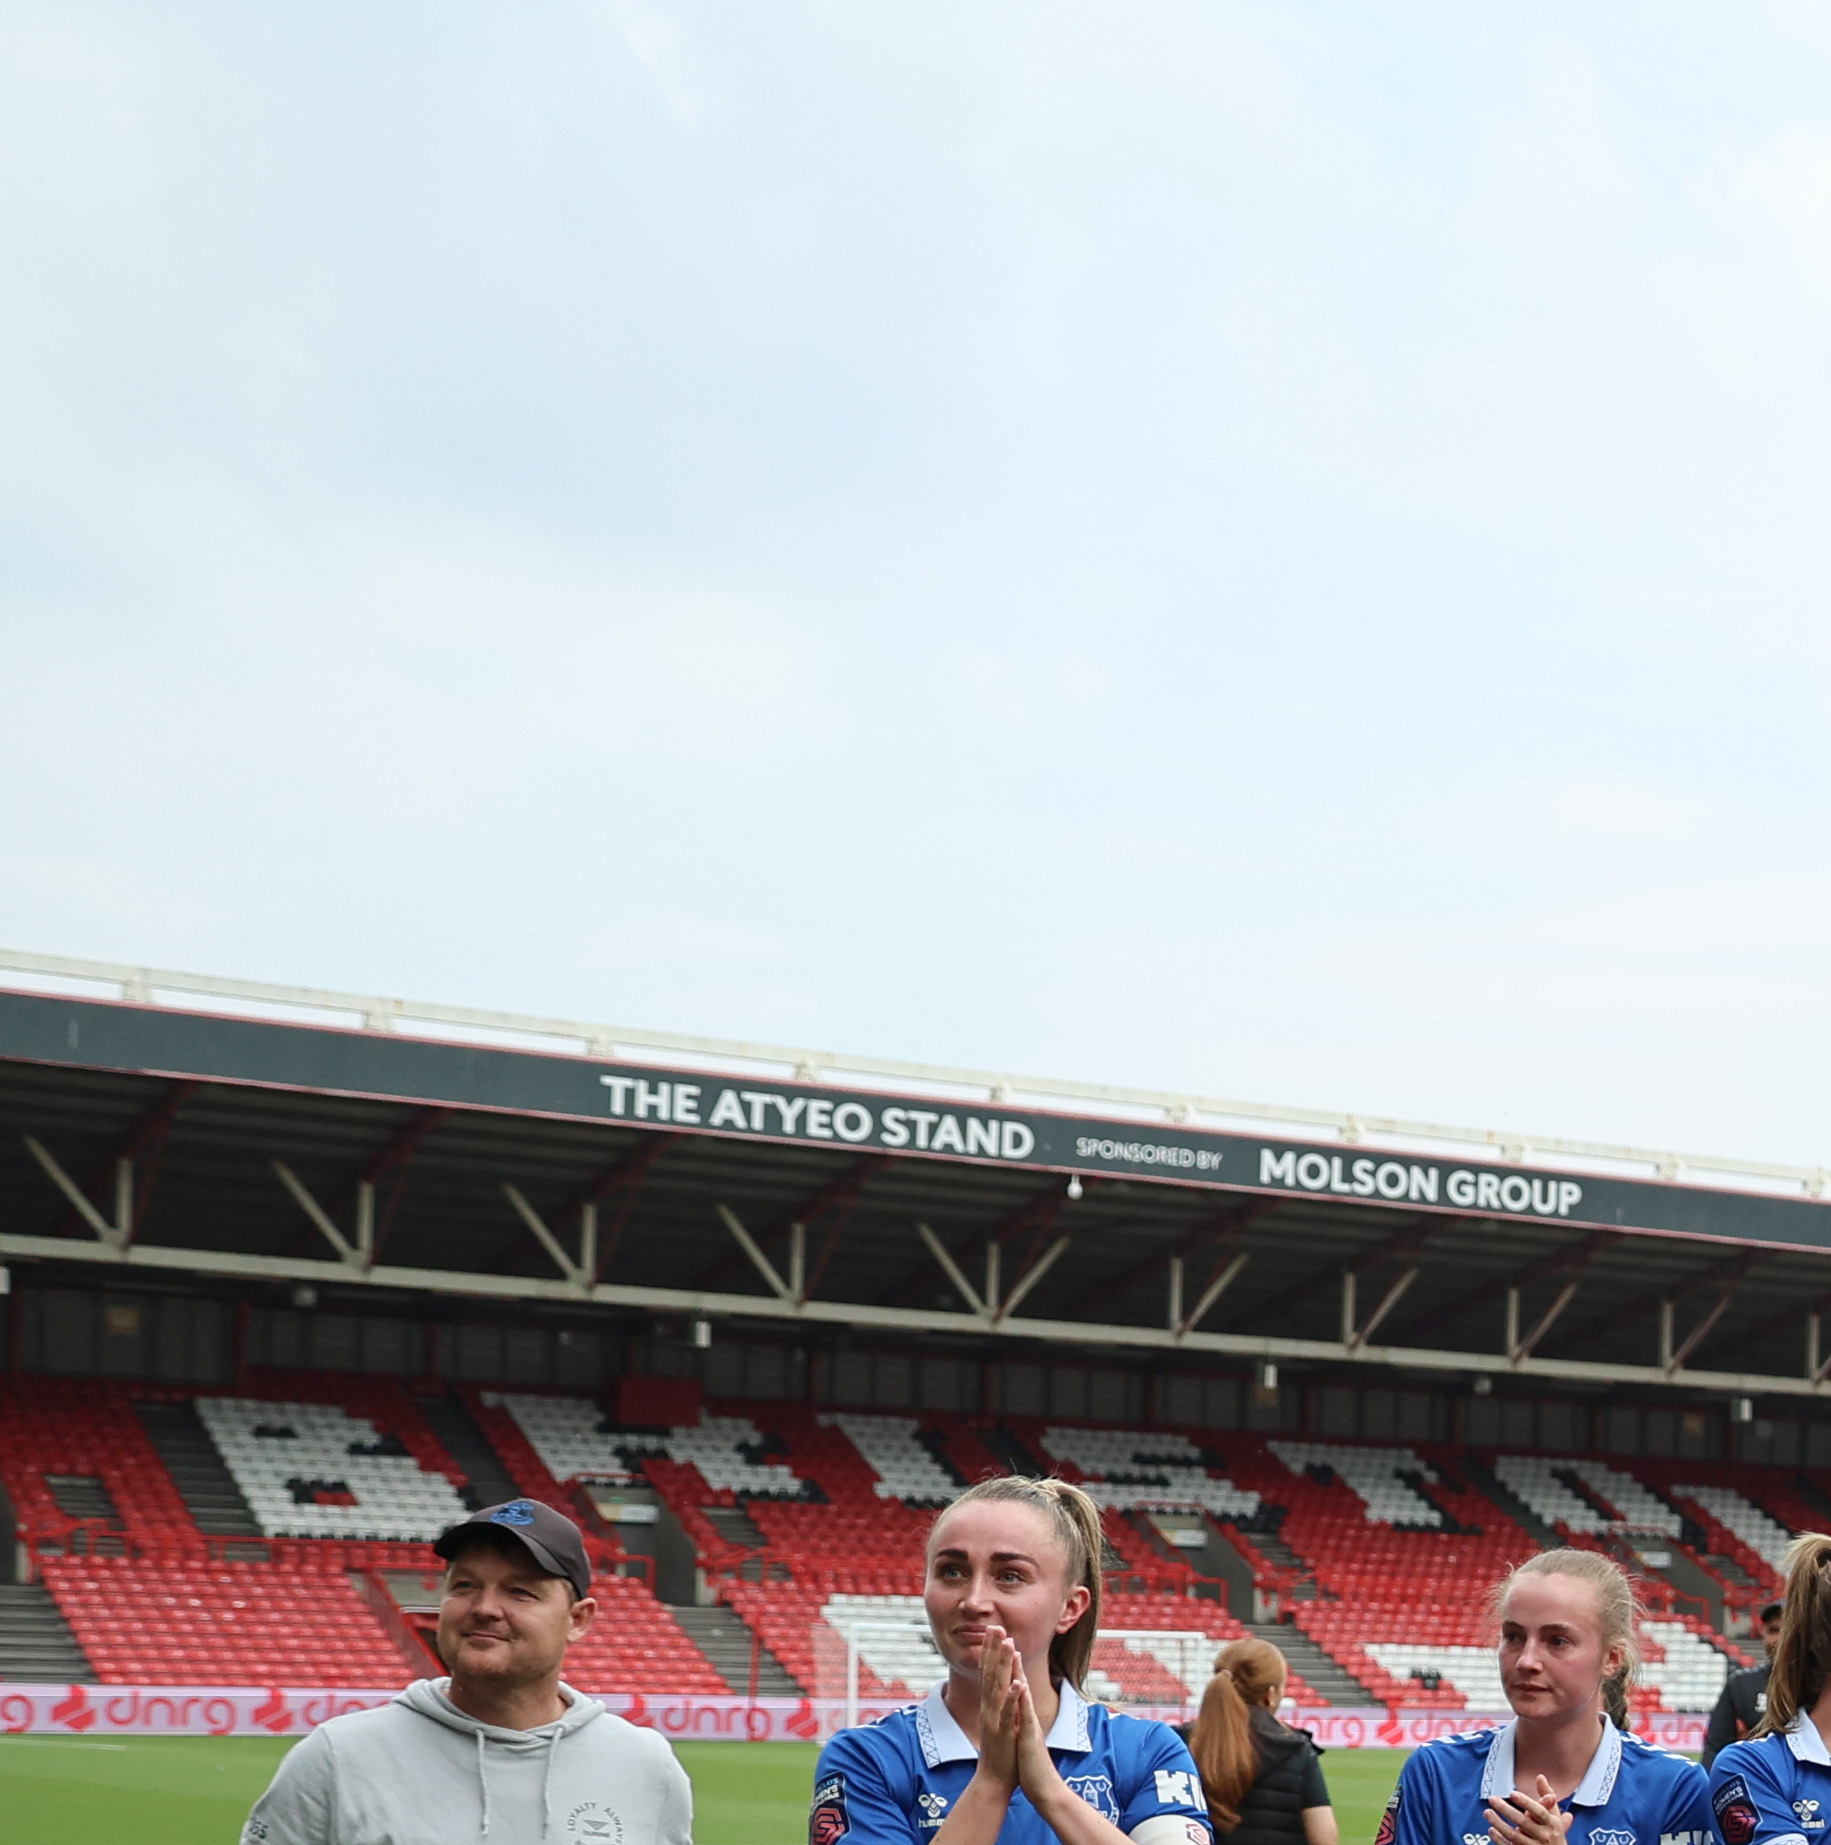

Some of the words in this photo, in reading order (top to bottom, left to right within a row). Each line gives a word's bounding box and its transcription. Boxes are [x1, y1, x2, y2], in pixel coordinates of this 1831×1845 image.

[600, 1074, 701, 1124] THE
[708, 1088, 873, 1143] ATYEO
[880, 1106, 1035, 1160] STAND
[1076, 1136, 1195, 1169] SPONSORED
[1196, 1150, 1223, 1171] BY
[1258, 1148, 1439, 1203] MOLSON
[1446, 1169, 1582, 1216] GROUP
[105, 1690, 238, 1736] dnrg
[661, 1700, 771, 1742] dnrg
[1154, 1769, 1208, 1811] KI
[567, 1802, 597, 1832] LOYALTY
[918, 1817, 945, 1829] humm
